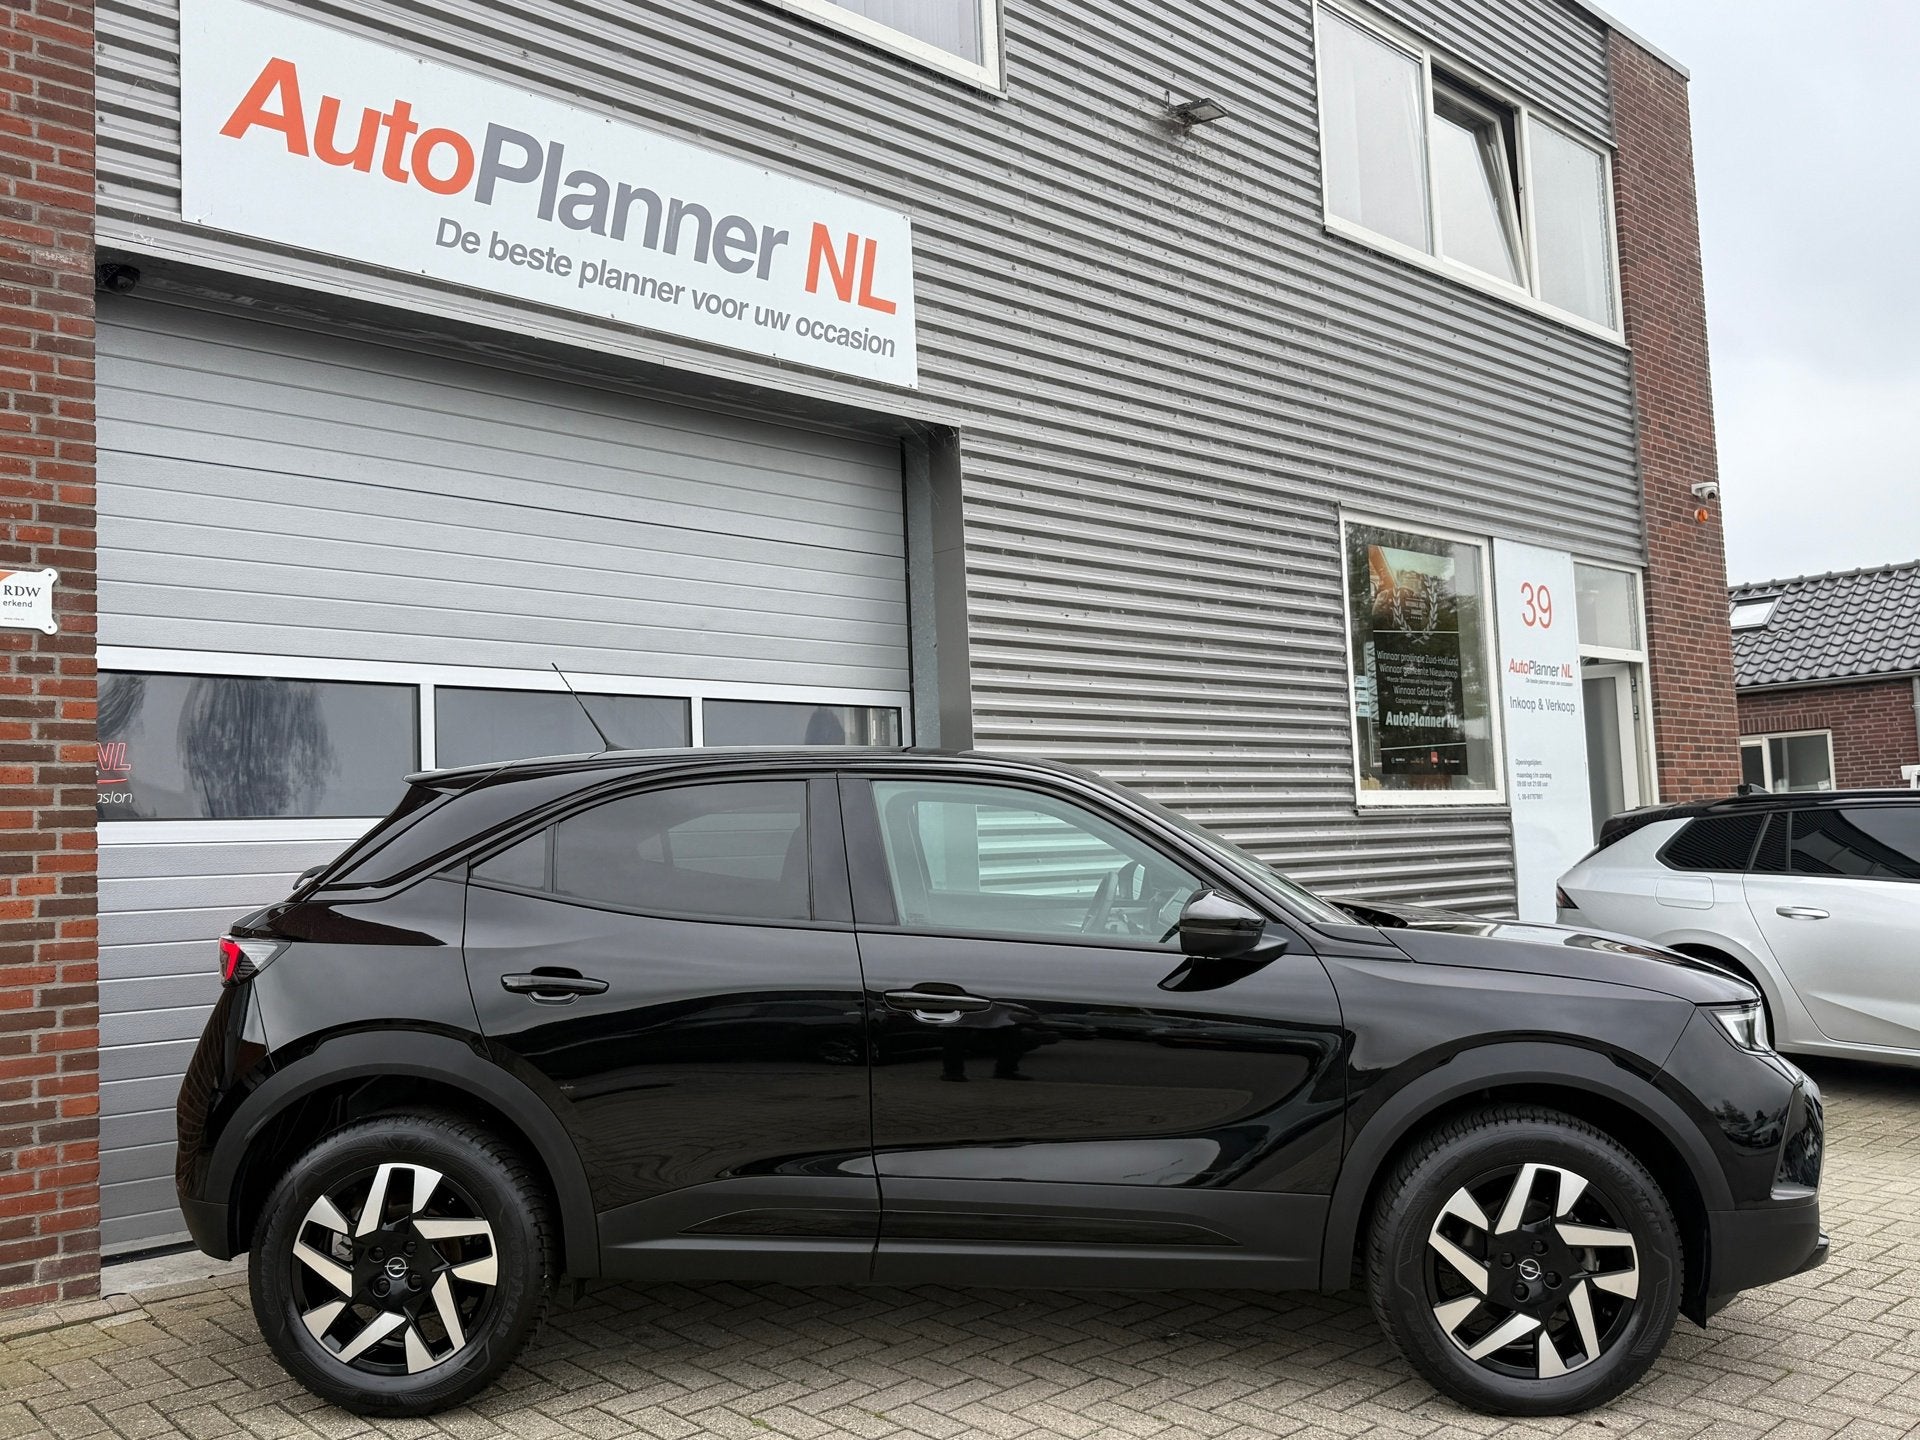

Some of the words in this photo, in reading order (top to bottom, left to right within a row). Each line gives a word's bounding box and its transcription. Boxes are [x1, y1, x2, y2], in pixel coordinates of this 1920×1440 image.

[219, 57, 789, 280] AutoPlanner
[805, 222, 896, 314] NL
[436, 218, 480, 254] De
[489, 231, 572, 276] beste
[579, 257, 685, 304] planner
[692, 290, 749, 320] voor
[755, 306, 790, 331] uw
[796, 317, 894, 357] occasion
[3, 584, 41, 598] RDW
[2, 599, 33, 608] erkend
[1520, 582, 1552, 629] 39
[1508, 658, 1560, 677] AutoPlanner
[1561, 663, 1573, 678] NL
[1510, 695, 1536, 713] Inkoop
[1538, 698, 1544, 711] &
[1545, 698, 1575, 716] Verkoop
[1385, 711, 1446, 728] AutoPlanner
